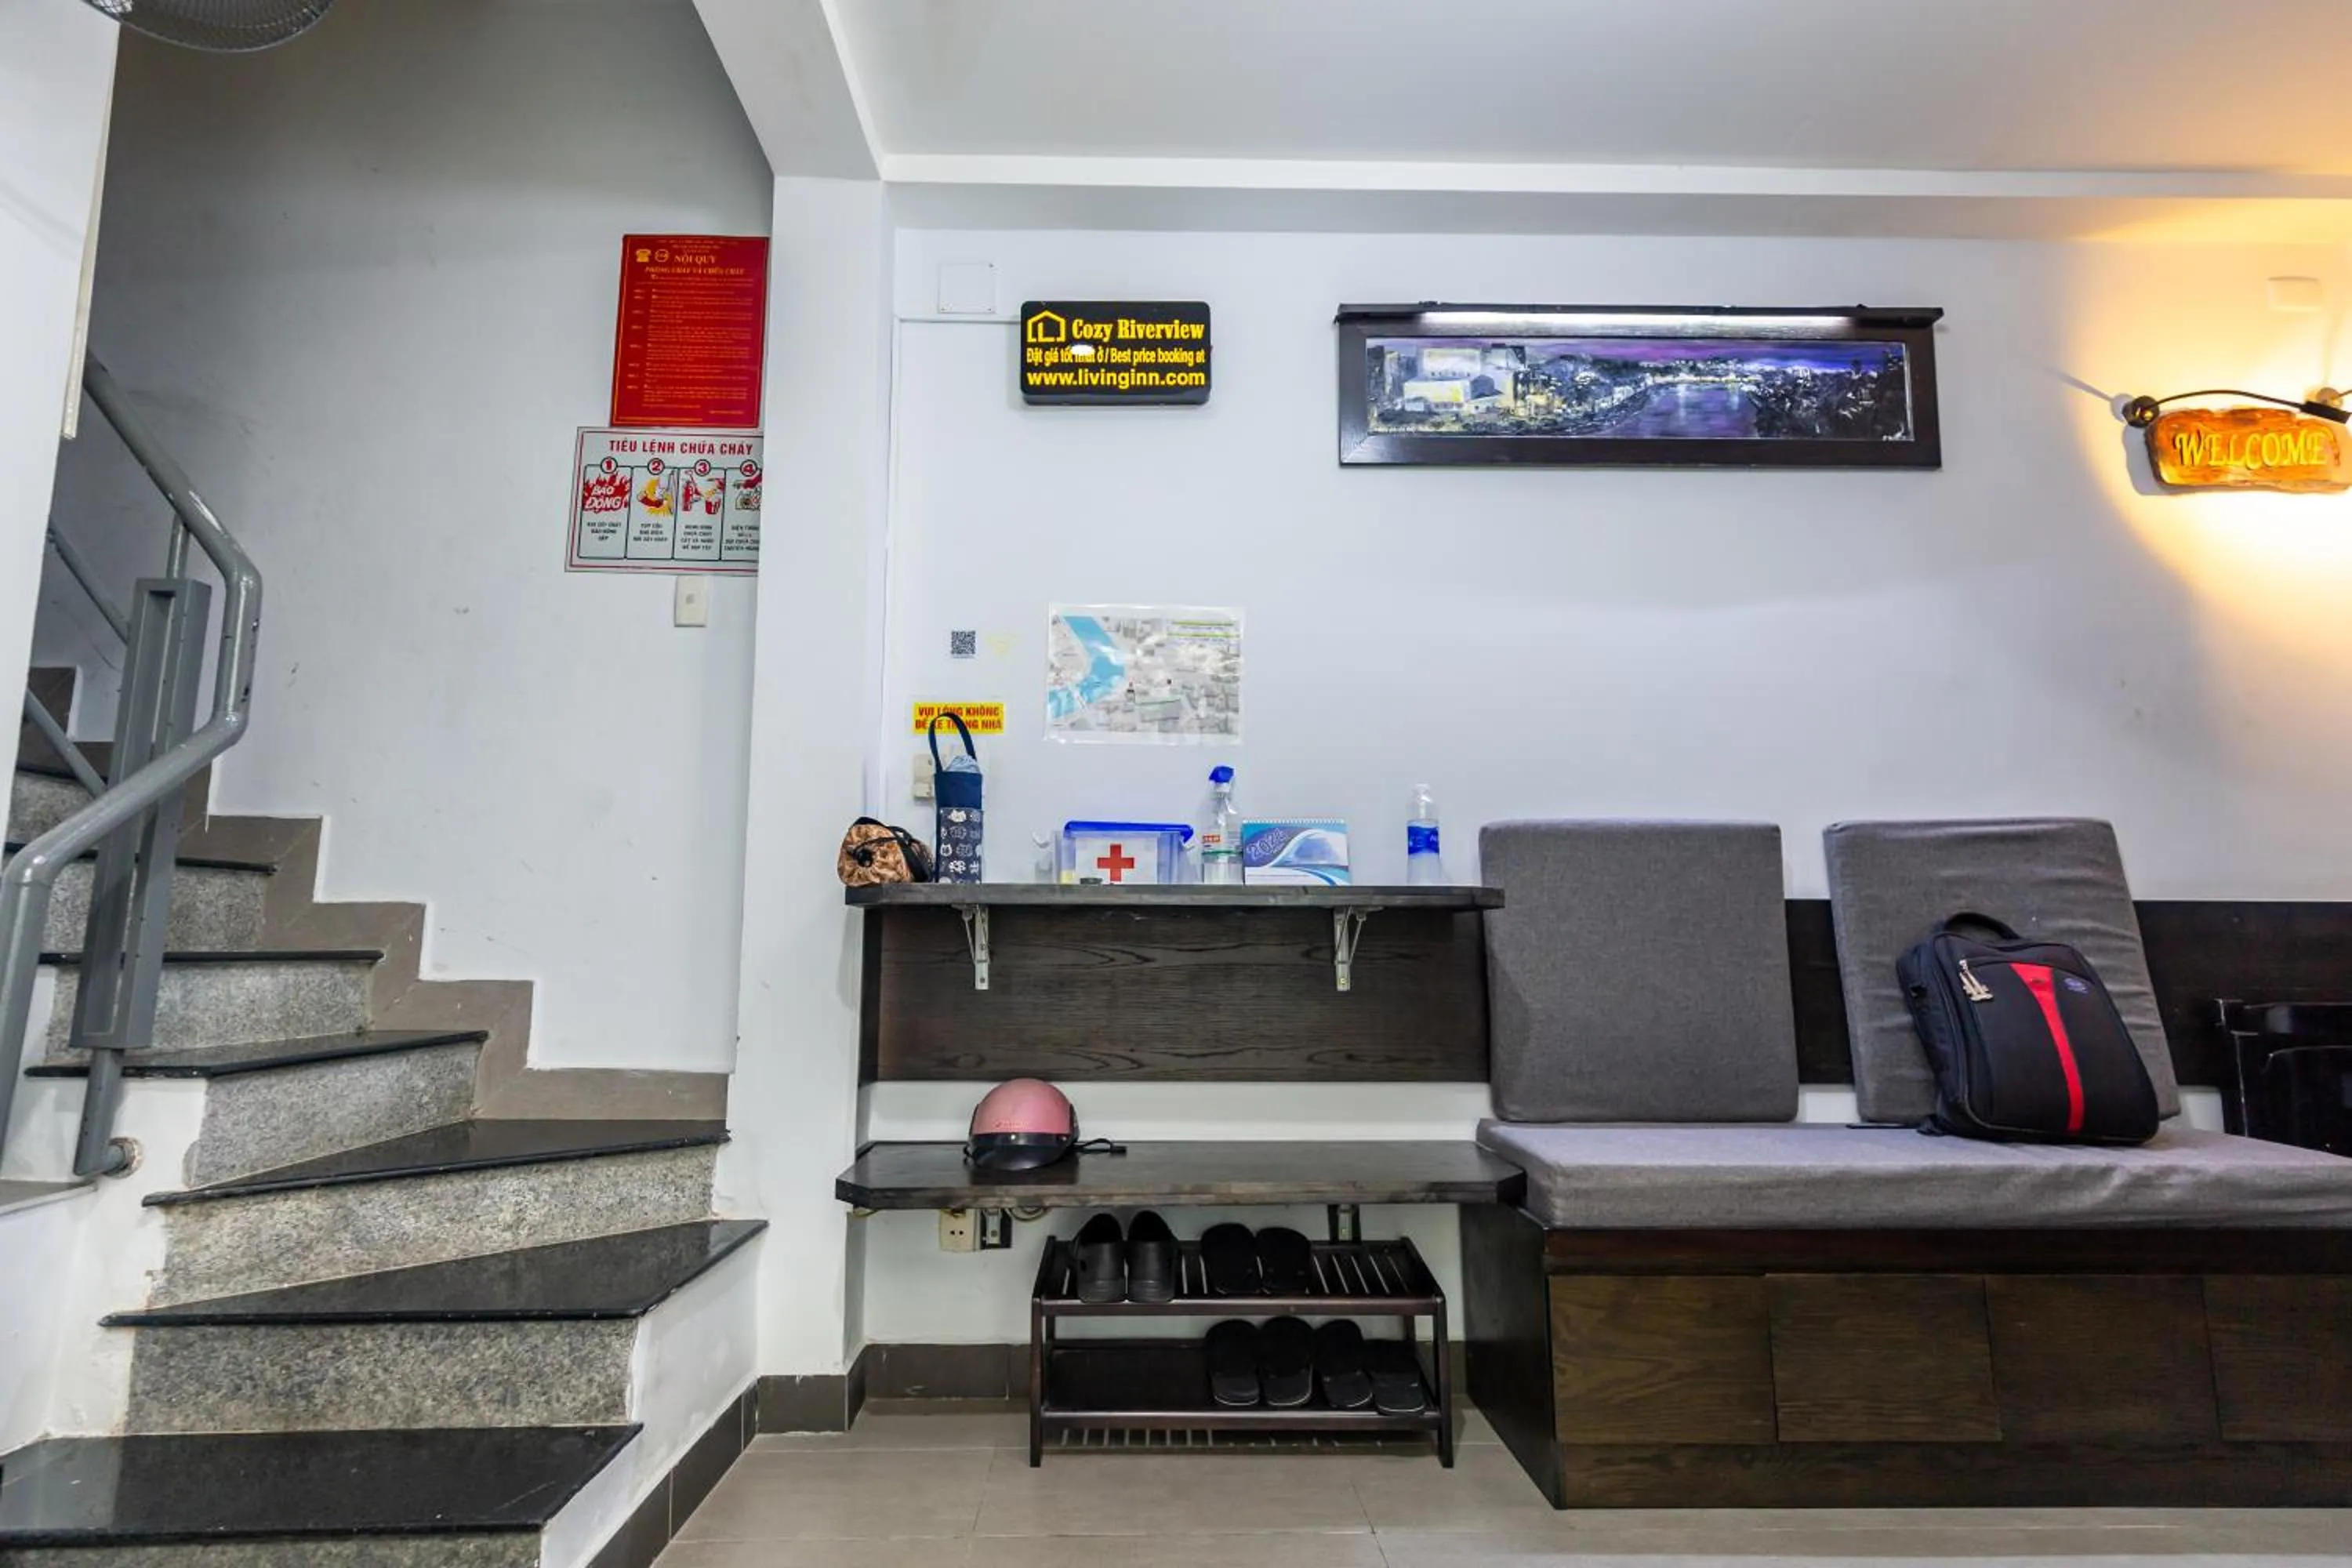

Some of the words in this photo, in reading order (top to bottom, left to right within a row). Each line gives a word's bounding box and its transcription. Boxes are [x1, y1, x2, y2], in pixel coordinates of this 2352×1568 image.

[1072, 318, 1113, 342] Cozy
[1117, 318, 1205, 339] Riverview
[1044, 347, 1058, 367] giá
[1109, 347, 1131, 363] Best
[1133, 347, 1156, 366] price
[1157, 347, 1194, 367] booking
[1196, 347, 1205, 363] at
[1026, 368, 1205, 390] www.livinginn.com
[642, 439, 675, 455] LỆNH
[720, 441, 753, 456] CHÁY
[2175, 427, 2328, 470] WELCOME
[604, 460, 612, 470] 1
[652, 462, 662, 471] 2
[698, 463, 708, 474] 3
[744, 463, 754, 474] 4
[966, 705, 1000, 716] KHÔNG
